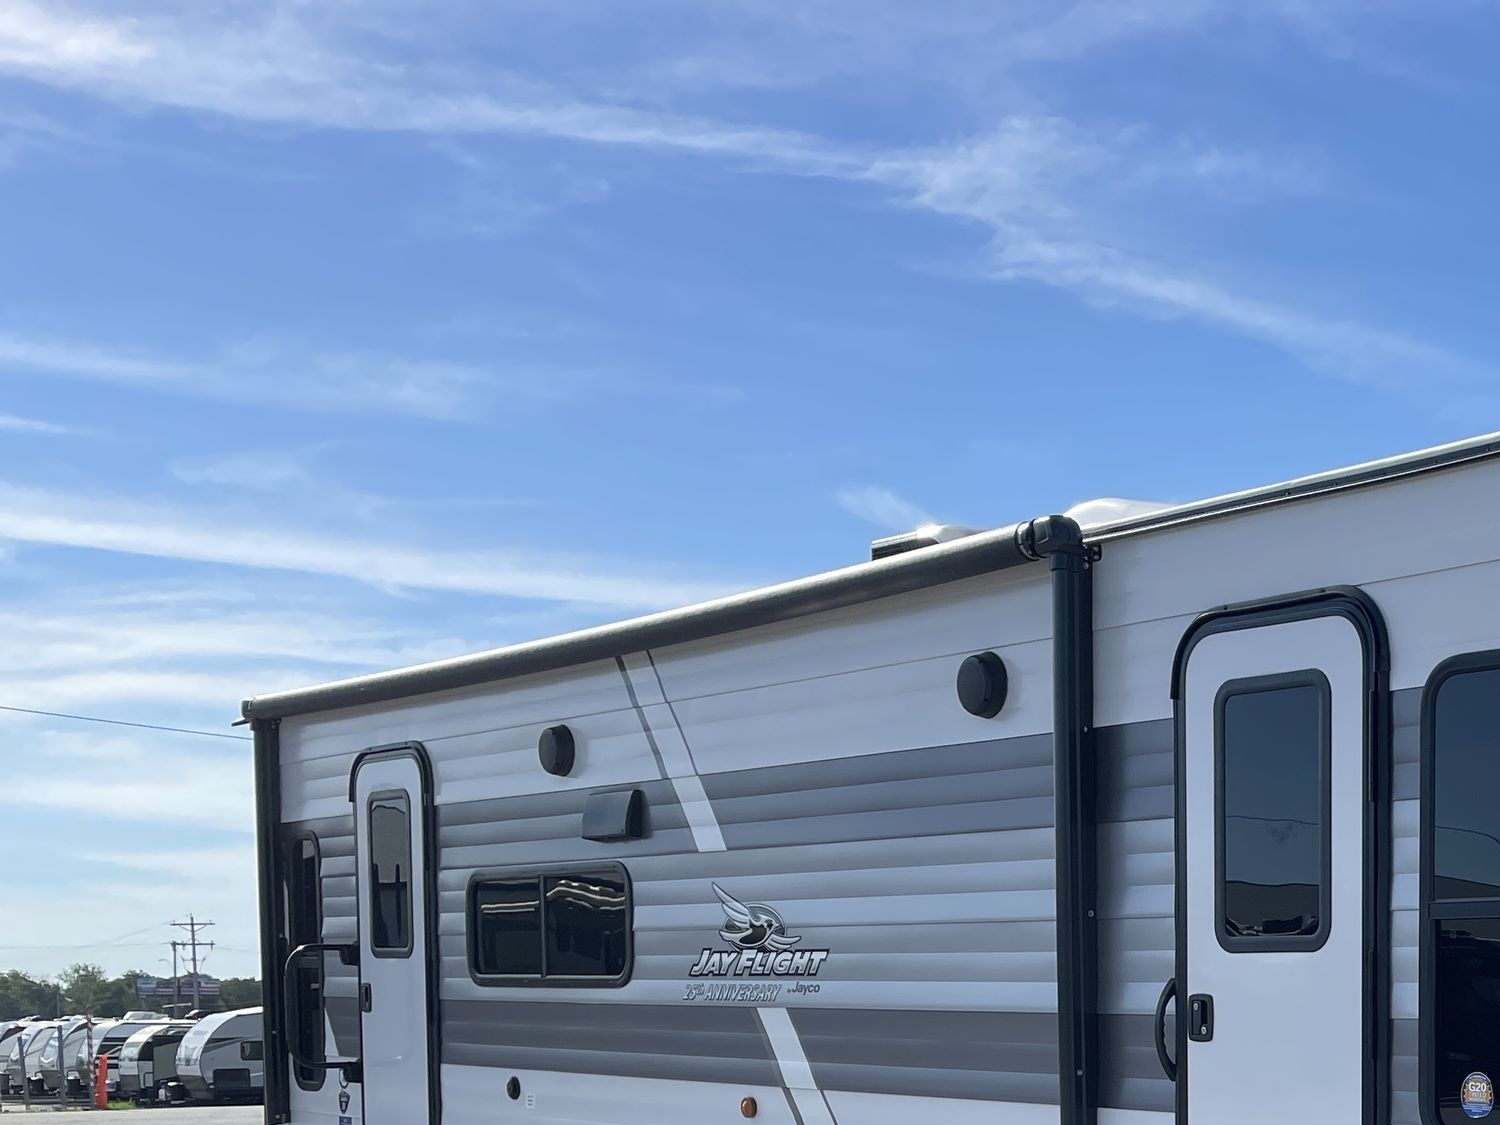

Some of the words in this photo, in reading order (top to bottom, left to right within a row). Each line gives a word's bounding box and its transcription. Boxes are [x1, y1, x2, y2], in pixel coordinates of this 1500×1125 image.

[689, 948, 738, 977] JAY
[734, 949, 830, 977] FLIGHT
[704, 984, 782, 1002] ANNIVERSARY
[792, 982, 820, 996] Jayco
[1468, 1082, 1487, 1092] G20
